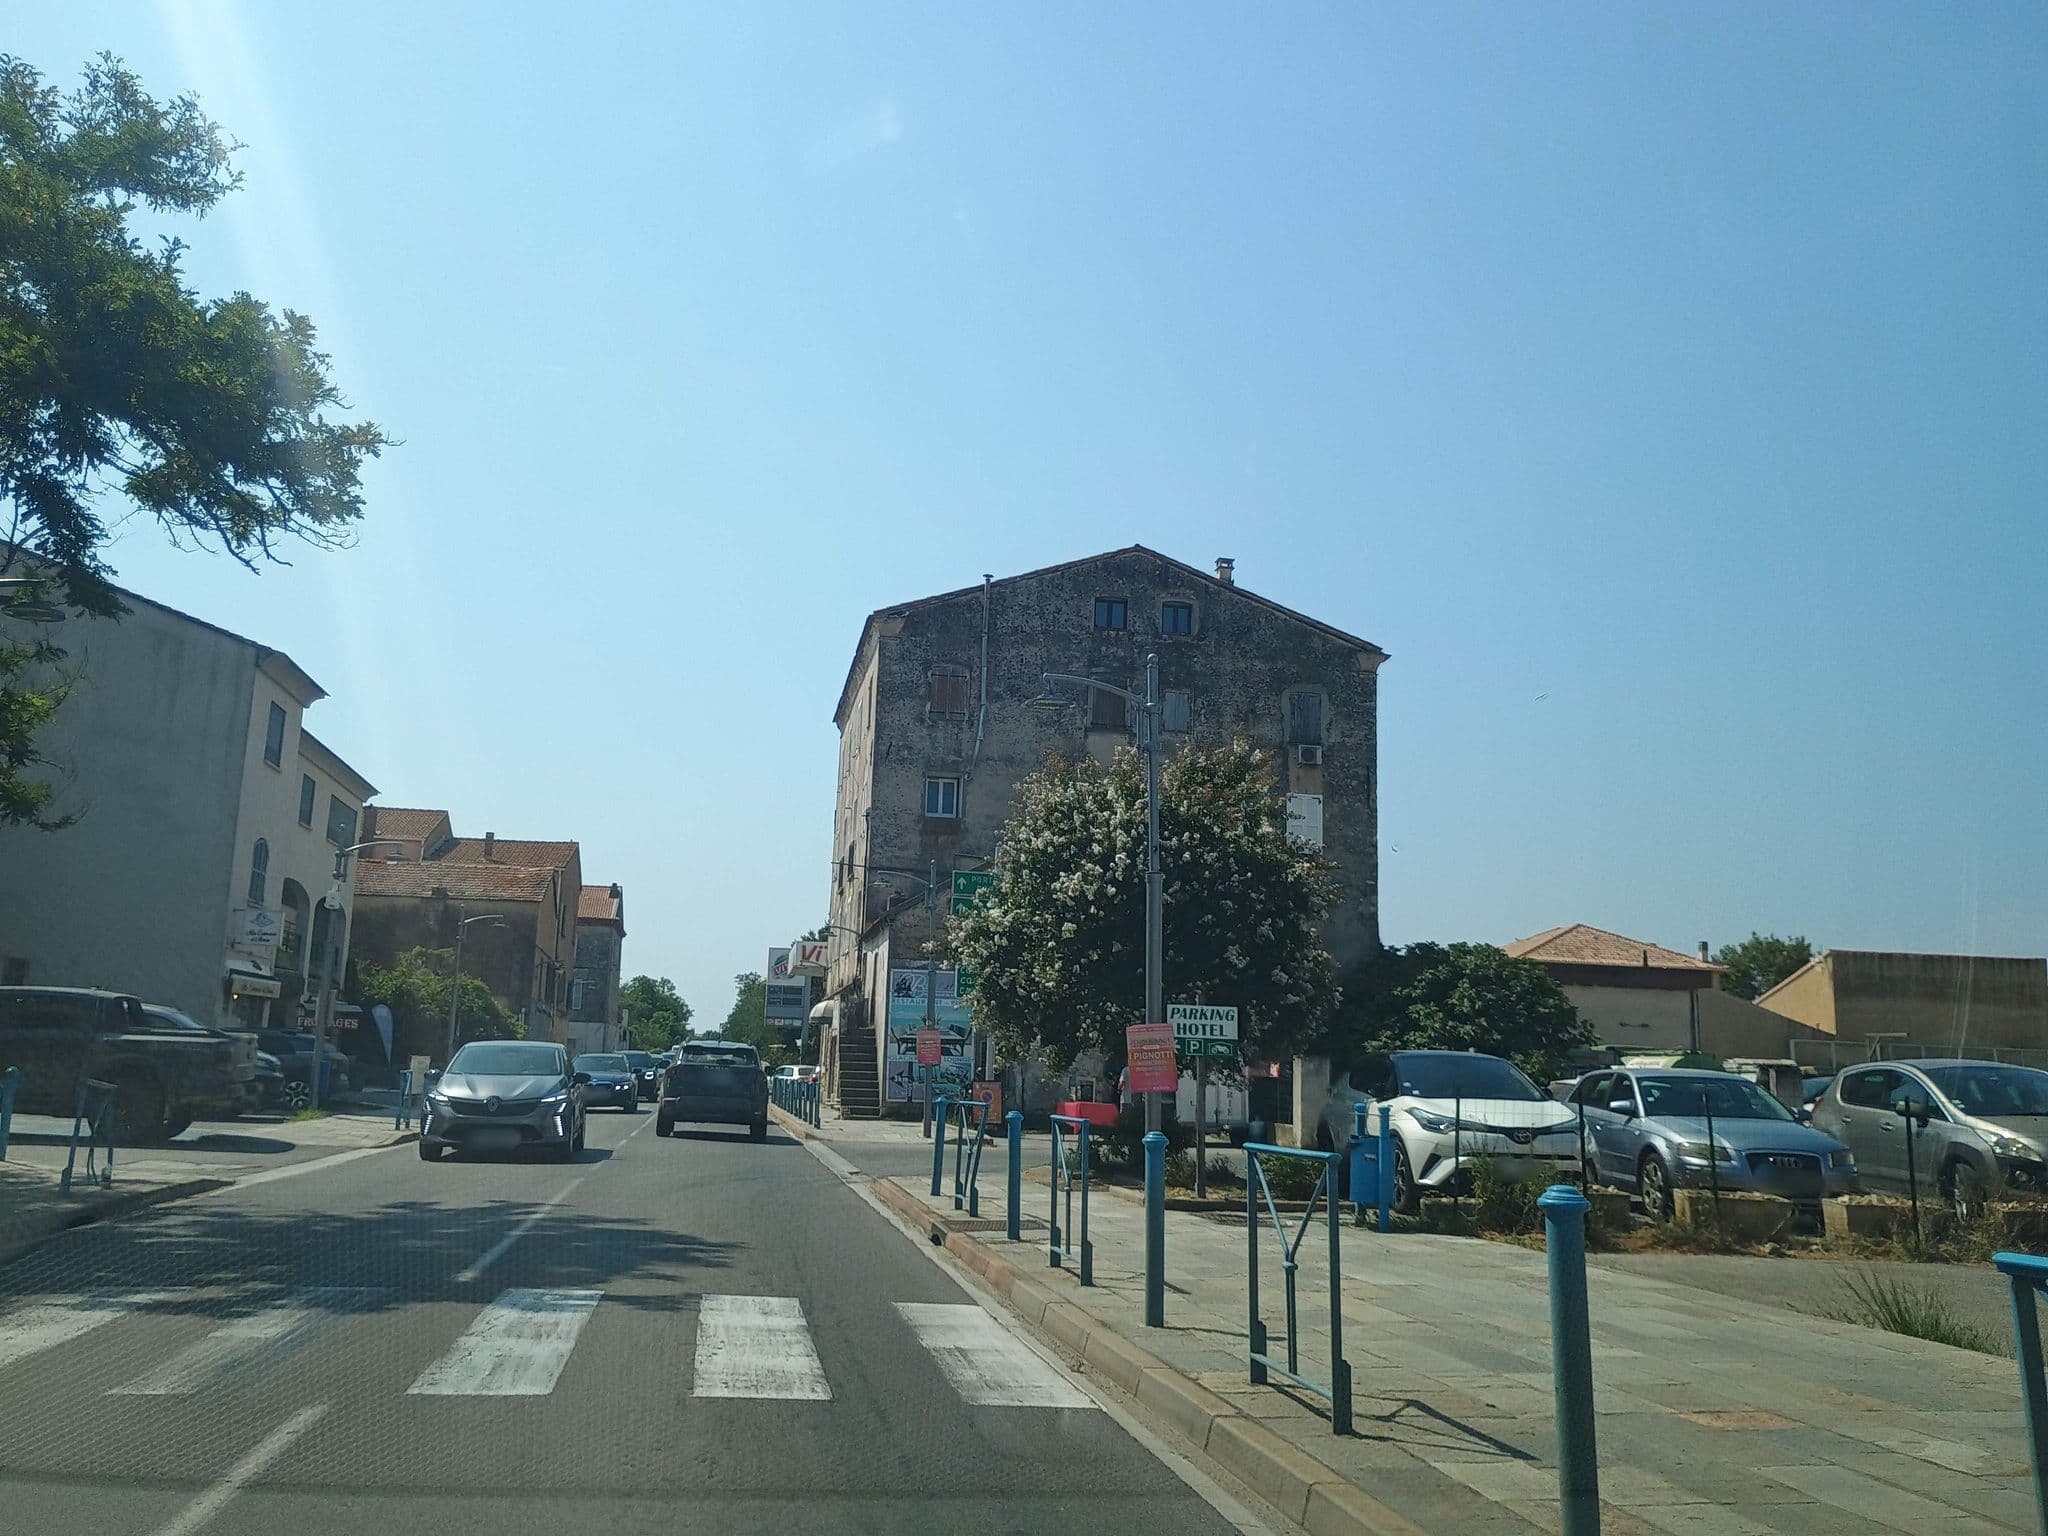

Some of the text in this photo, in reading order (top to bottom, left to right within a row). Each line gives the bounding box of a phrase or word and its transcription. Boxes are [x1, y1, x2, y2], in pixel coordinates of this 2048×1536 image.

[802, 945, 828, 961] Vi
[1170, 1007, 1236, 1021] PARKING
[1176, 1022, 1228, 1037] HOTEL
[1134, 1050, 1174, 1060] PIGNOTTI
